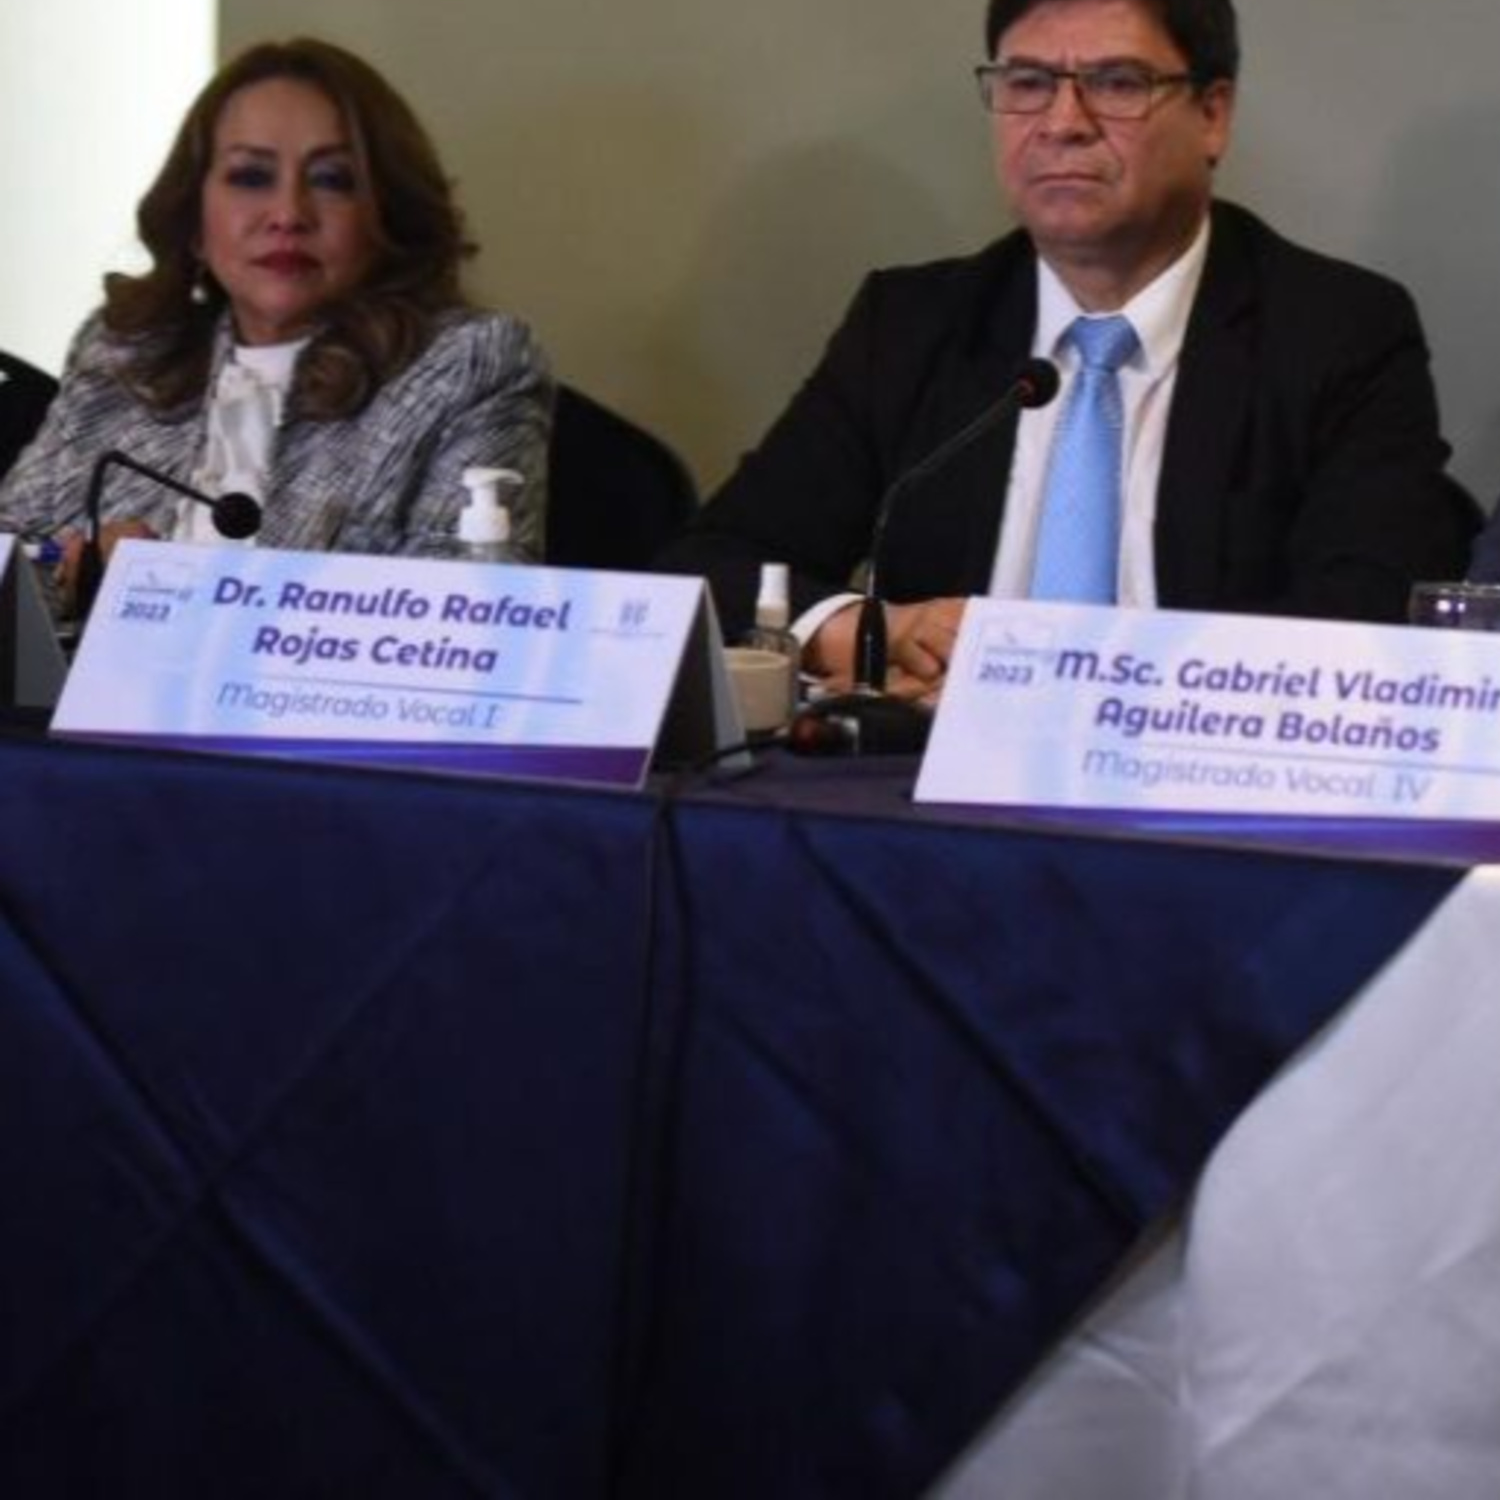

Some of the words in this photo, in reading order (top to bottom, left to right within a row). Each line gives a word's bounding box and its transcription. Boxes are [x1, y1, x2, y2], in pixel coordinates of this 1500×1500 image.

[213, 576, 266, 608] Dr.
[277, 581, 430, 620] Ranulfo
[440, 593, 572, 631] Rafael
[251, 625, 360, 665] Rojas
[370, 635, 498, 673] Cetina
[1176, 658, 1321, 699] Gabriel
[216, 681, 389, 718] Magistrado
[397, 699, 475, 727] Vocal
[484, 703, 501, 729] I
[1095, 697, 1264, 739] Aguilera
[1275, 711, 1441, 752] Bolaños
[1082, 748, 1275, 788] Magistrado
[1285, 766, 1374, 799] Vocal
[1392, 772, 1433, 801] IV
